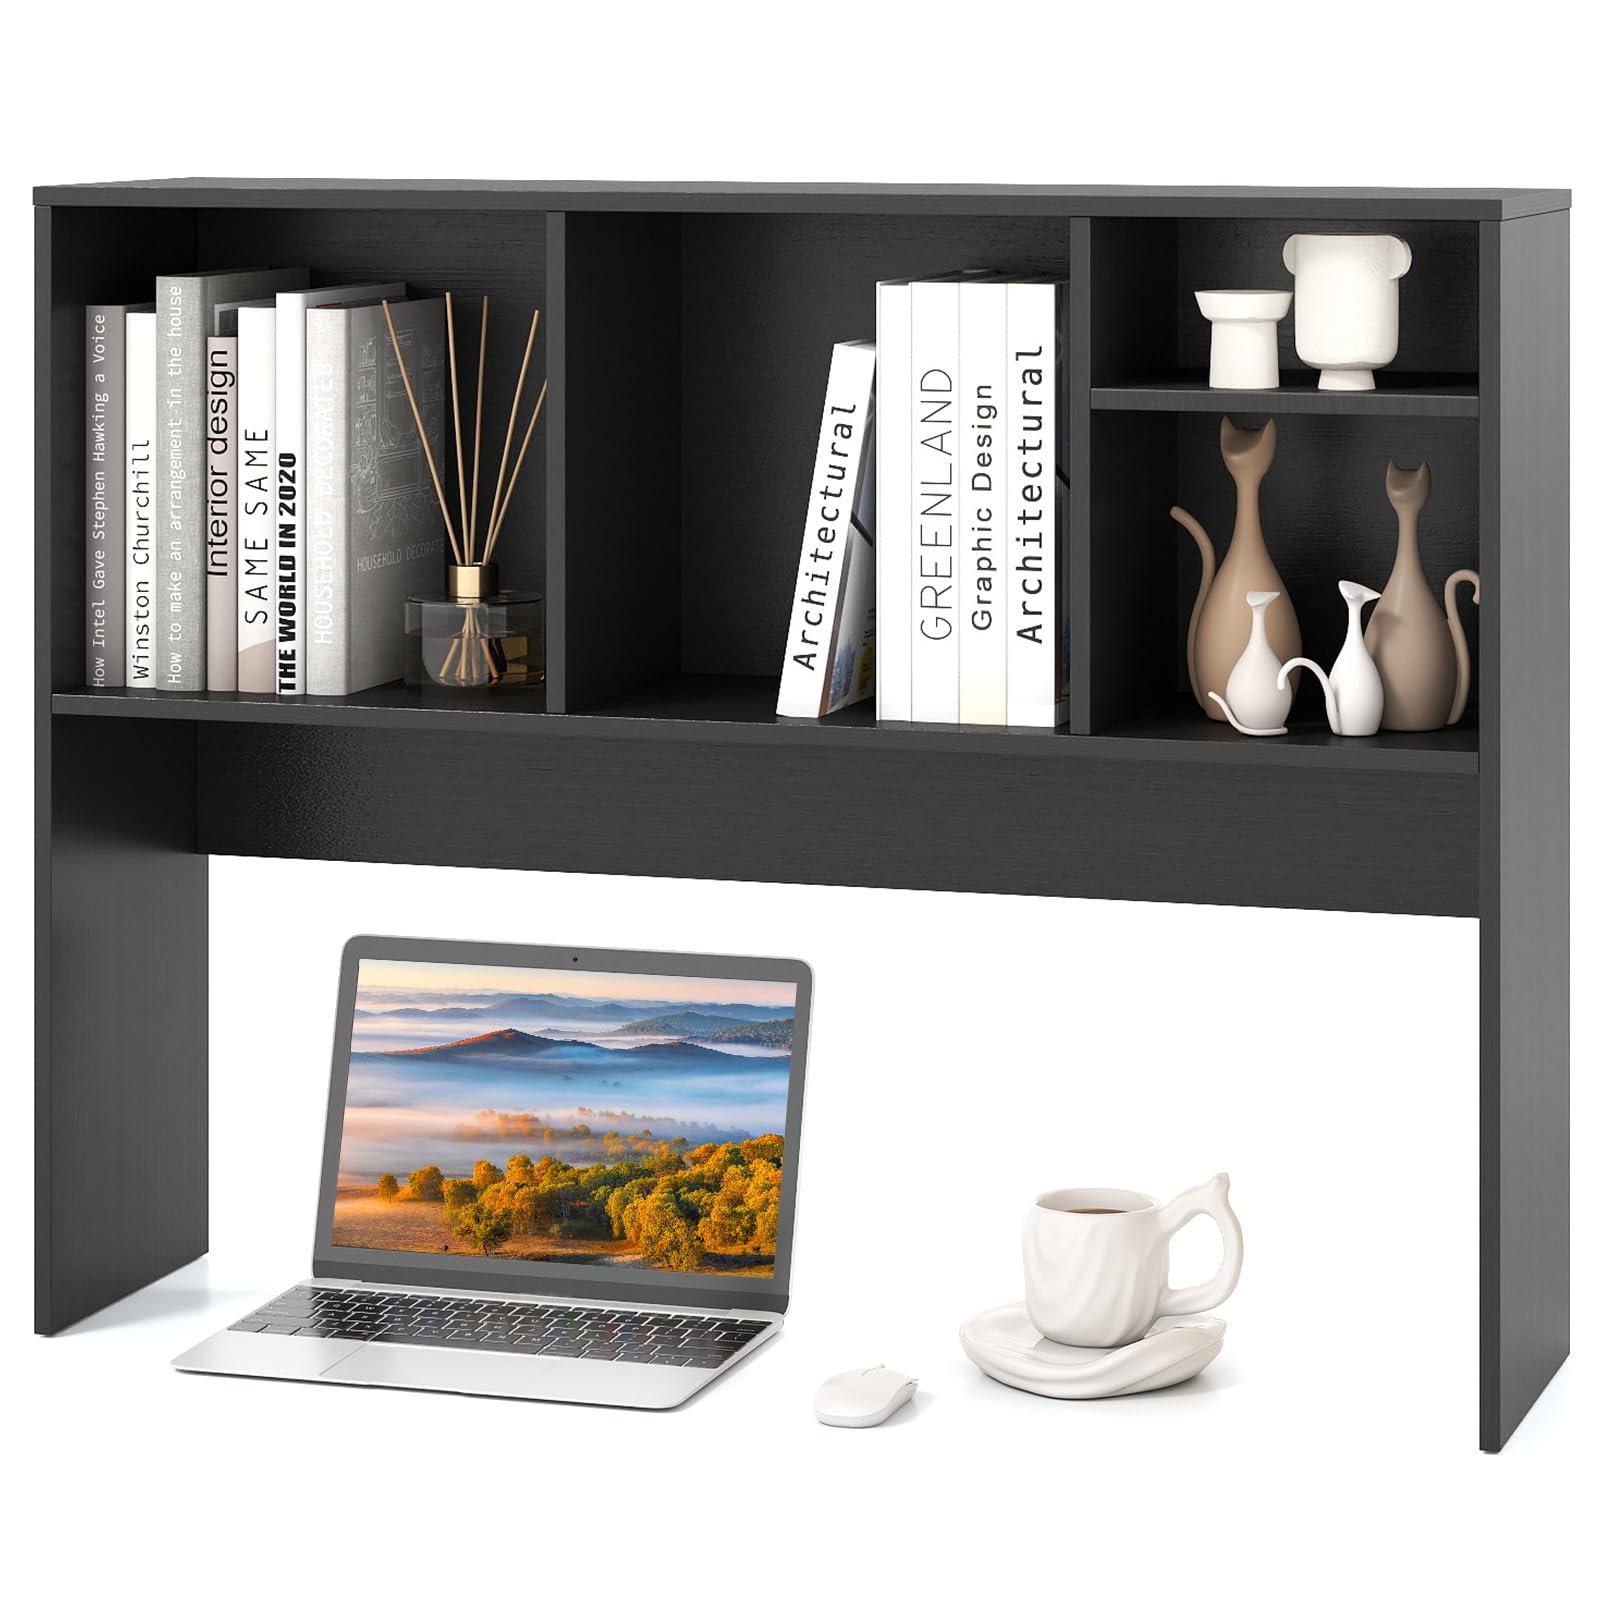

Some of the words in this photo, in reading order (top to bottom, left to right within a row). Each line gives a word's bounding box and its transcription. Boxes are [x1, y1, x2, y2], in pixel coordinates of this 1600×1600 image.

[91, 314, 105, 363] Voice
[167, 286, 183, 337] house
[94, 373, 105, 383] a
[167, 347, 183, 377] the
[91, 392, 109, 462] Hawking
[167, 388, 183, 410] in
[207, 349, 235, 455] design
[313, 363, 334, 496] DECORATES
[244, 428, 268, 515] SAME
[971, 384, 997, 492] Design
[91, 471, 108, 540] Stephen
[132, 439, 150, 565] Churchill
[168, 419, 186, 530] arrangement
[278, 452, 297, 516] 2020
[920, 368, 953, 640] GREENLAND
[1015, 345, 1043, 645] Architectural
[170, 541, 183, 561] an
[207, 466, 228, 577] Interior
[278, 523, 297, 548] IN
[792, 402, 857, 671] Architectural
[91, 549, 105, 589] Gave
[167, 571, 183, 613] make
[244, 537, 268, 624] SAME
[313, 511, 334, 644] HOUSEHOLD
[357, 547, 402, 574] HOUSEHOLD
[971, 507, 997, 631] Graphic
[91, 599, 105, 648] Intel
[132, 580, 150, 679] Winston
[167, 622, 183, 642] to
[278, 555, 297, 642] WORLD
[91, 654, 105, 687] How
[167, 653, 183, 683] How
[278, 649, 297, 693] THE
